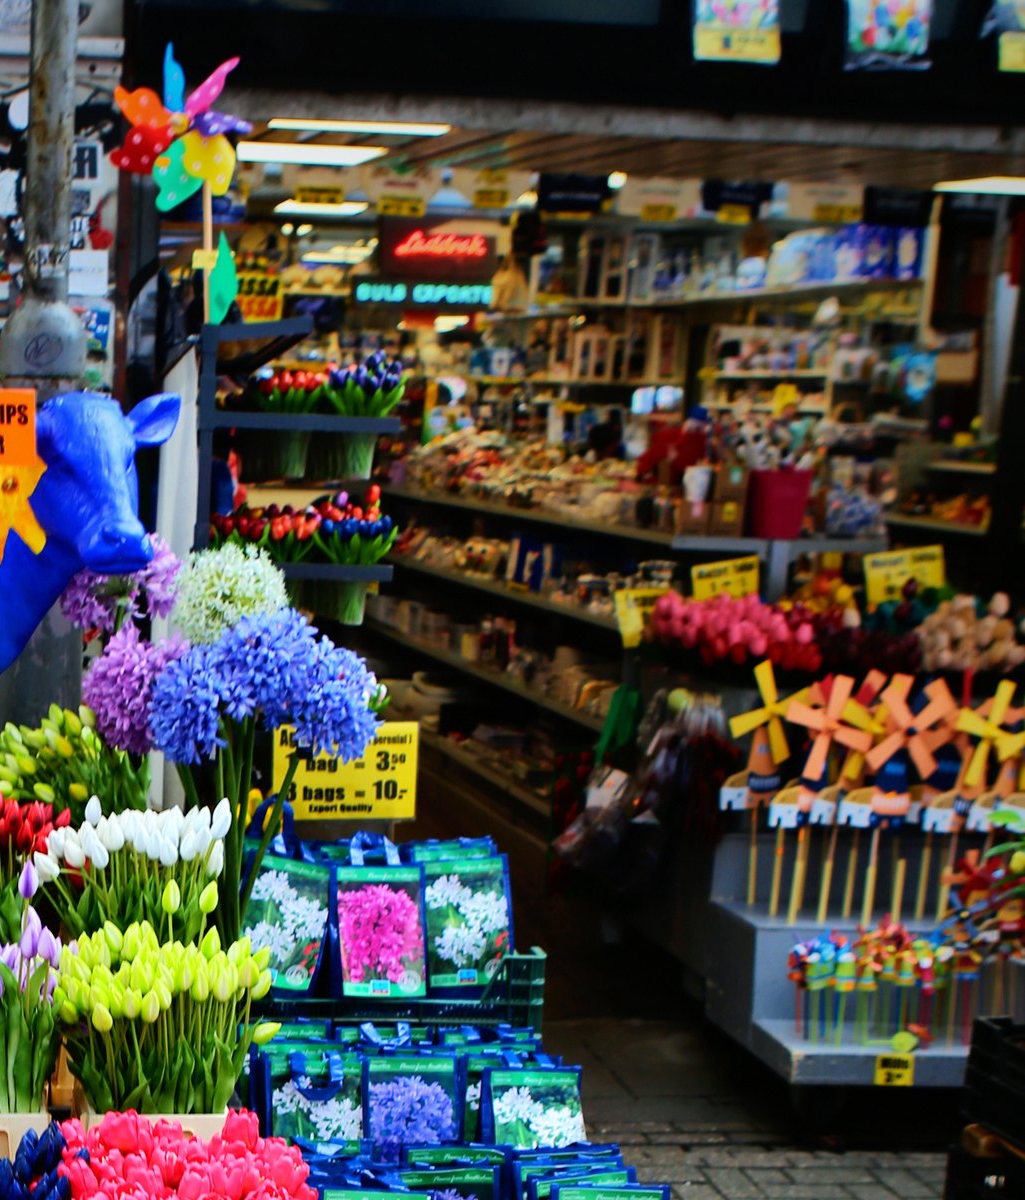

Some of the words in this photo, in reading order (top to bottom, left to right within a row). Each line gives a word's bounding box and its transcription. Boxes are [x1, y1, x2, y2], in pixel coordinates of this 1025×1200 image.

[303, 785, 345, 801] bags
[309, 804, 337, 813] Export
[339, 804, 372, 812] Quality
